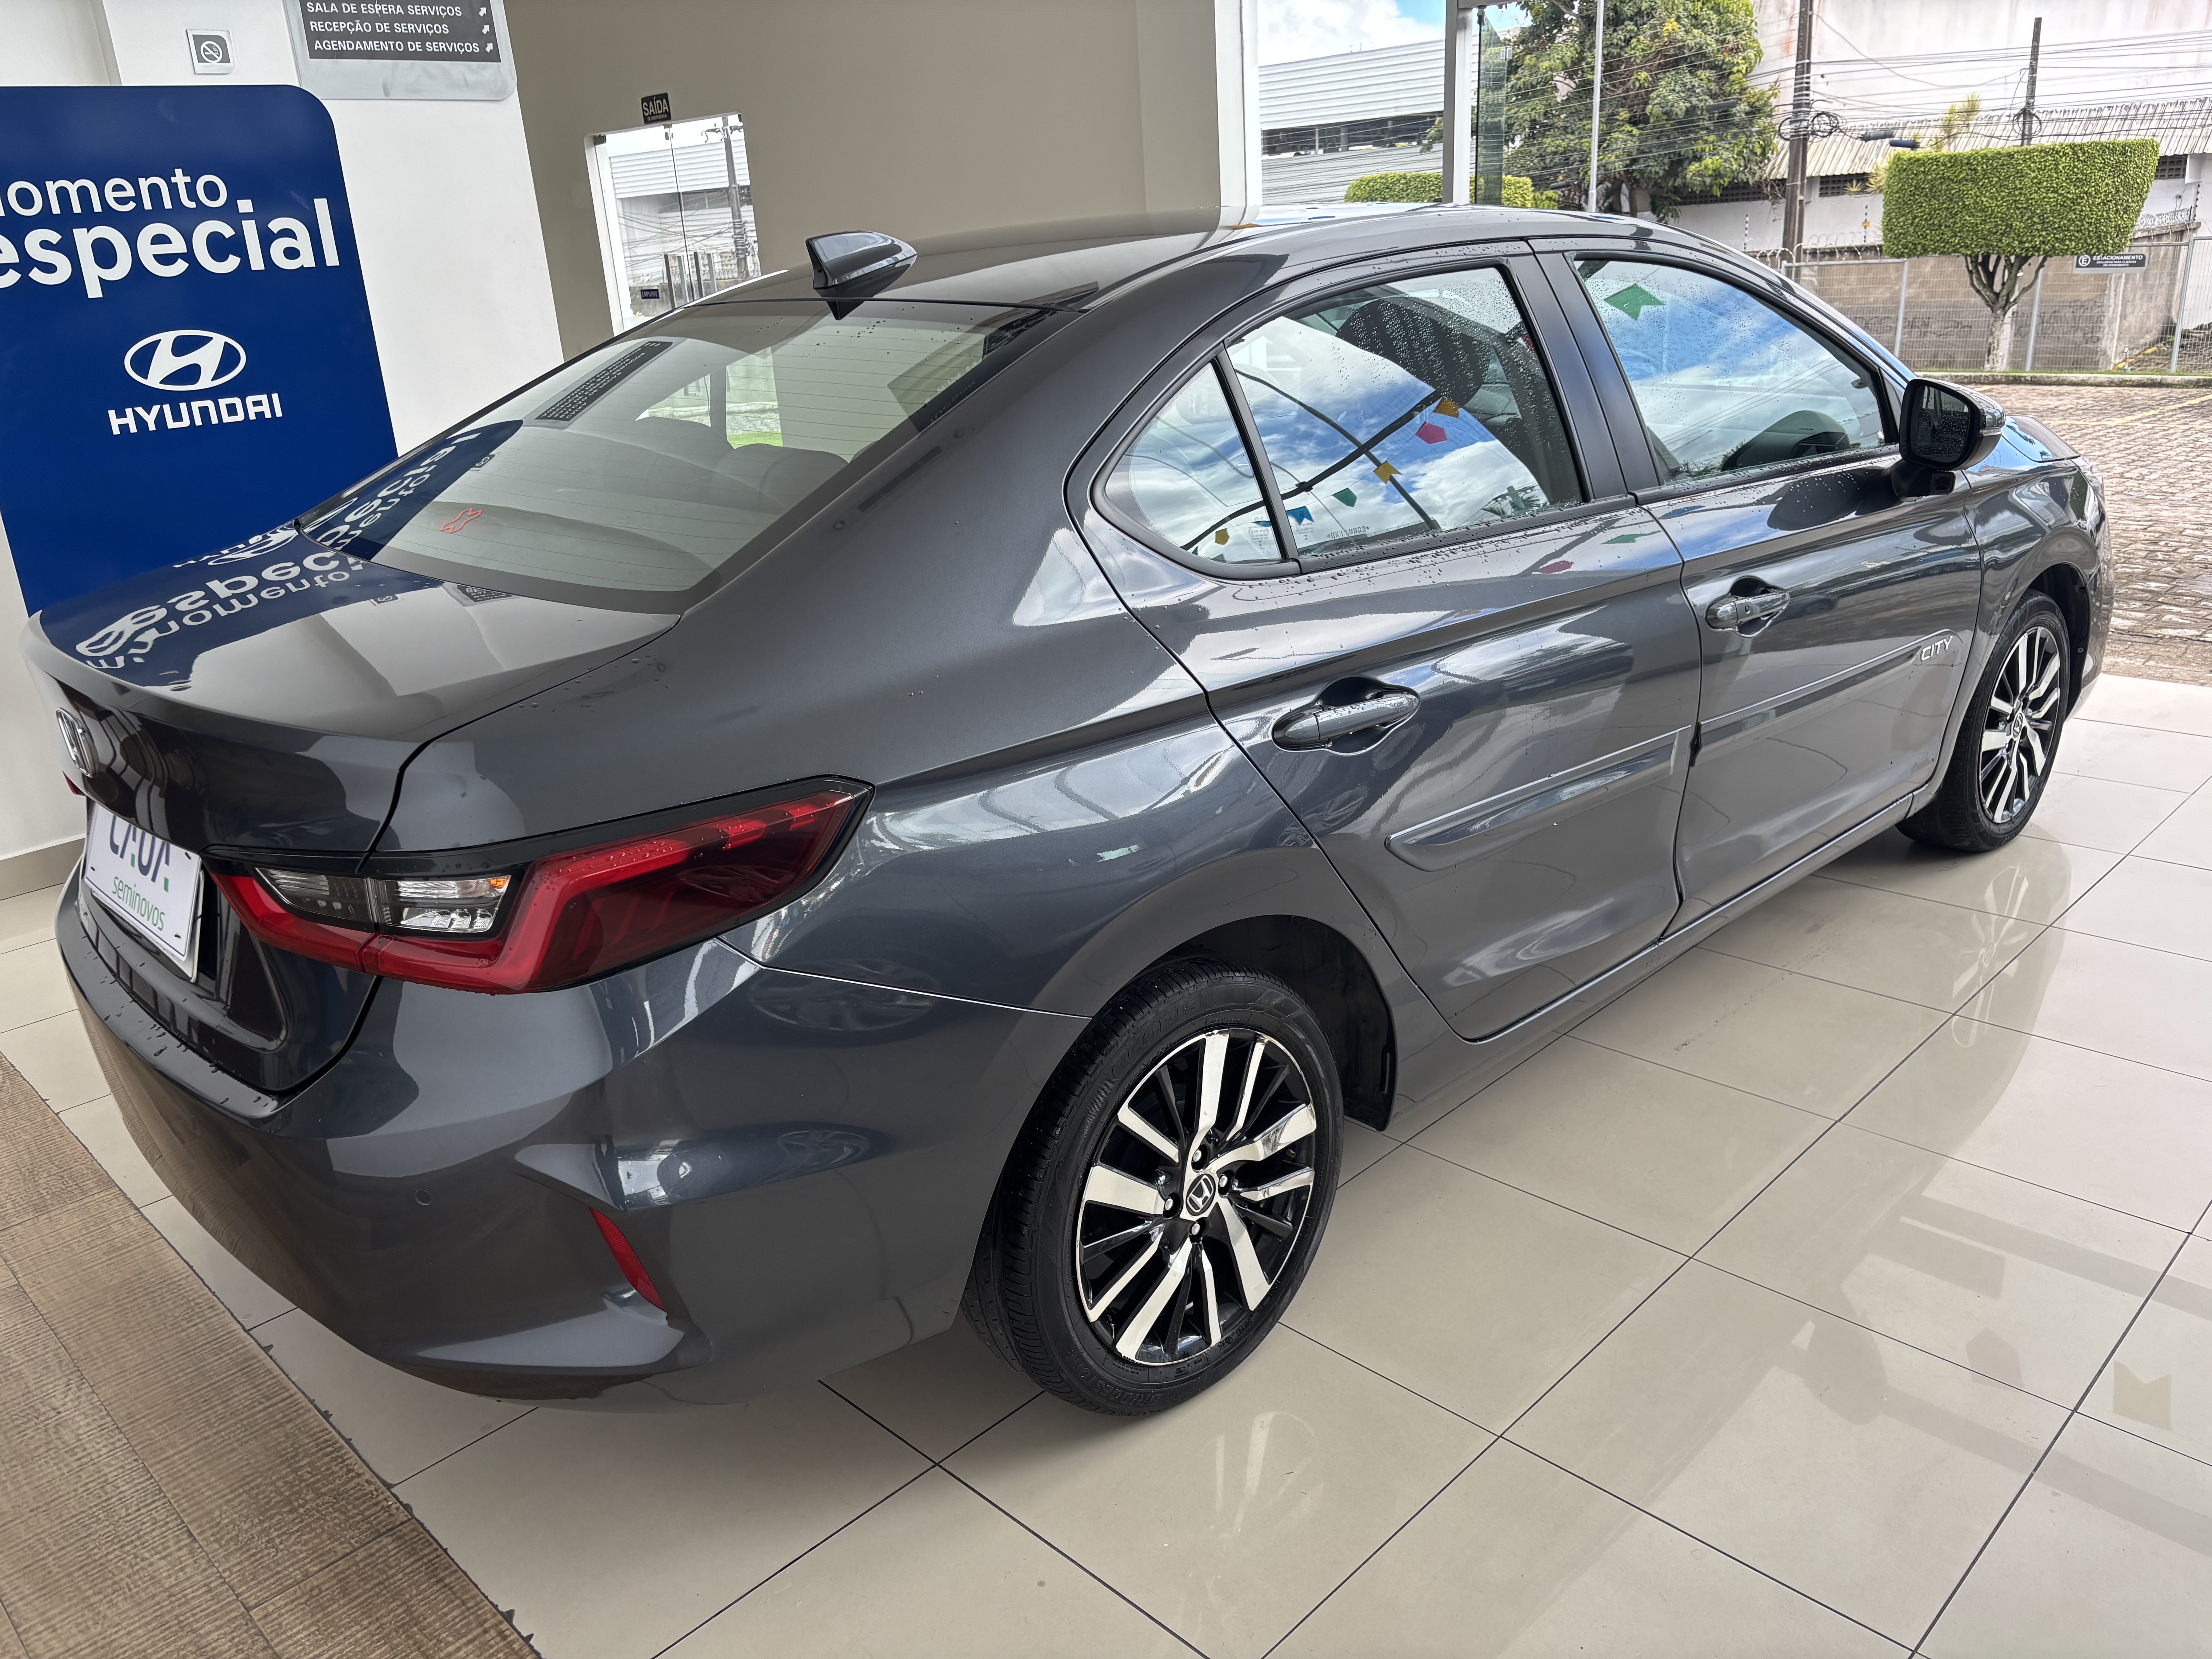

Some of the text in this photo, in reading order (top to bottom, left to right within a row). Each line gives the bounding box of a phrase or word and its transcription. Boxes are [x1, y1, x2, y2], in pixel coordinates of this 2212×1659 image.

[307, 2, 462, 18] SALA DE ESPERA SERVIÇOS
[310, 20, 449, 36] RECEPÇÃO DE SERVIÇOS
[314, 40, 480, 55] AGENDAMENTO DE SERVIÇOS
[643, 96, 669, 116] SAÍDA
[0, 168, 227, 216] omento
[108, 393, 283, 435] HYUNDAI
[1920, 635, 1953, 661] CITY
[112, 876, 165, 931] seminovos
